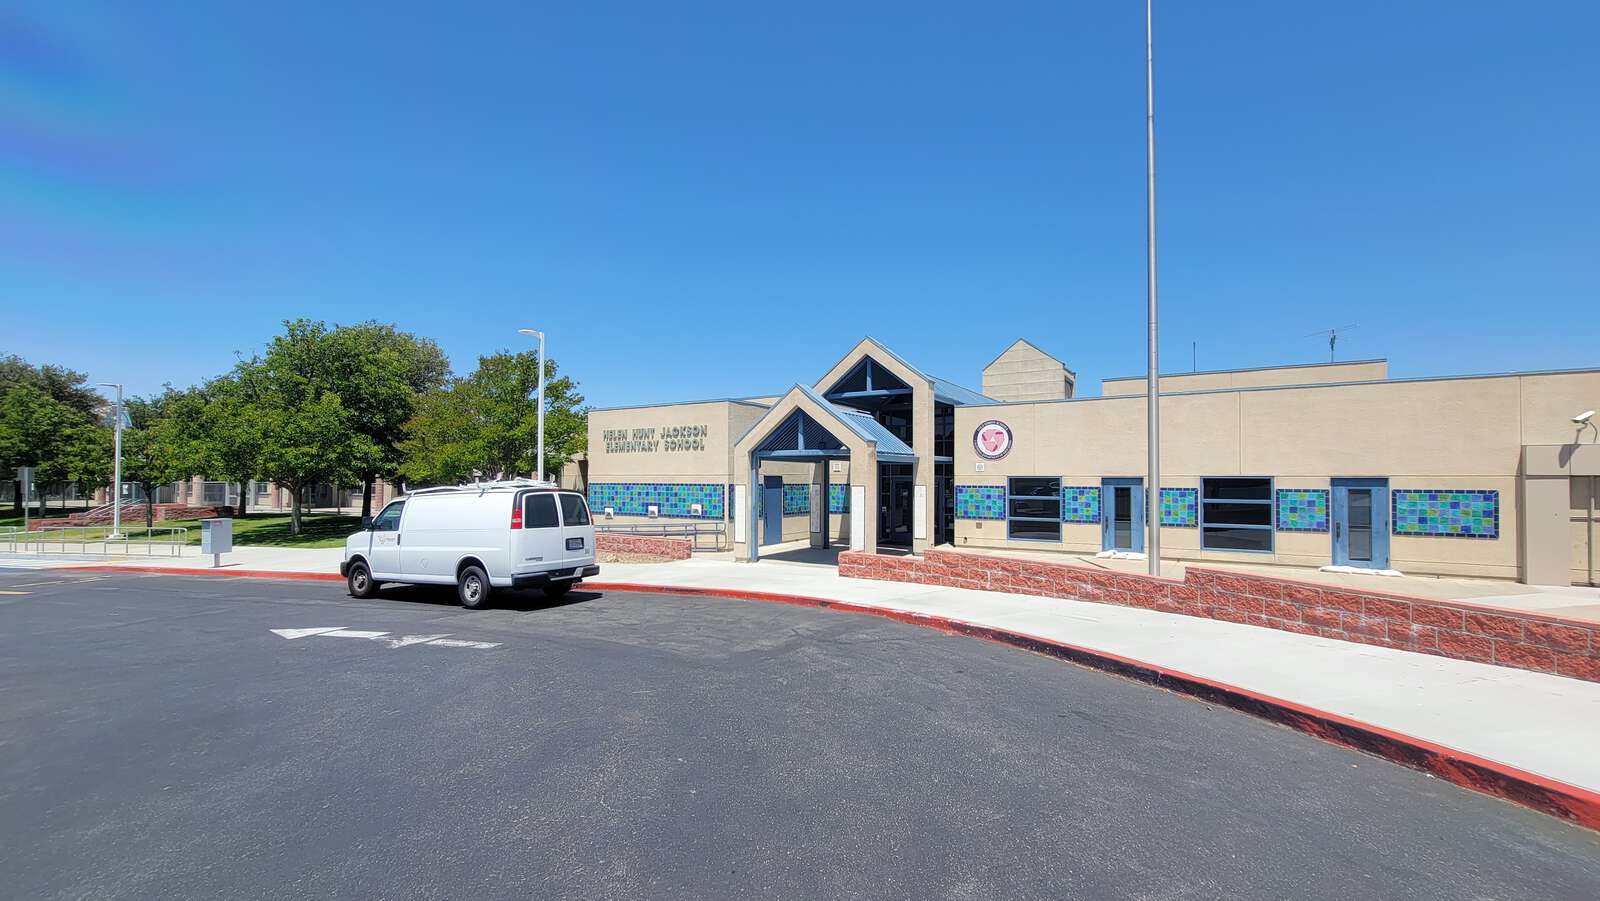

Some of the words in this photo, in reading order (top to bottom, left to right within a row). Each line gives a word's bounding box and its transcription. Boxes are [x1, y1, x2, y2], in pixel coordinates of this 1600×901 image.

[602, 430, 628, 441] HELEN
[632, 428, 656, 440] HUNT
[660, 425, 708, 439] JACKSON
[606, 440, 659, 453] ELEMENTARY
[664, 439, 705, 452] SCHOOL
